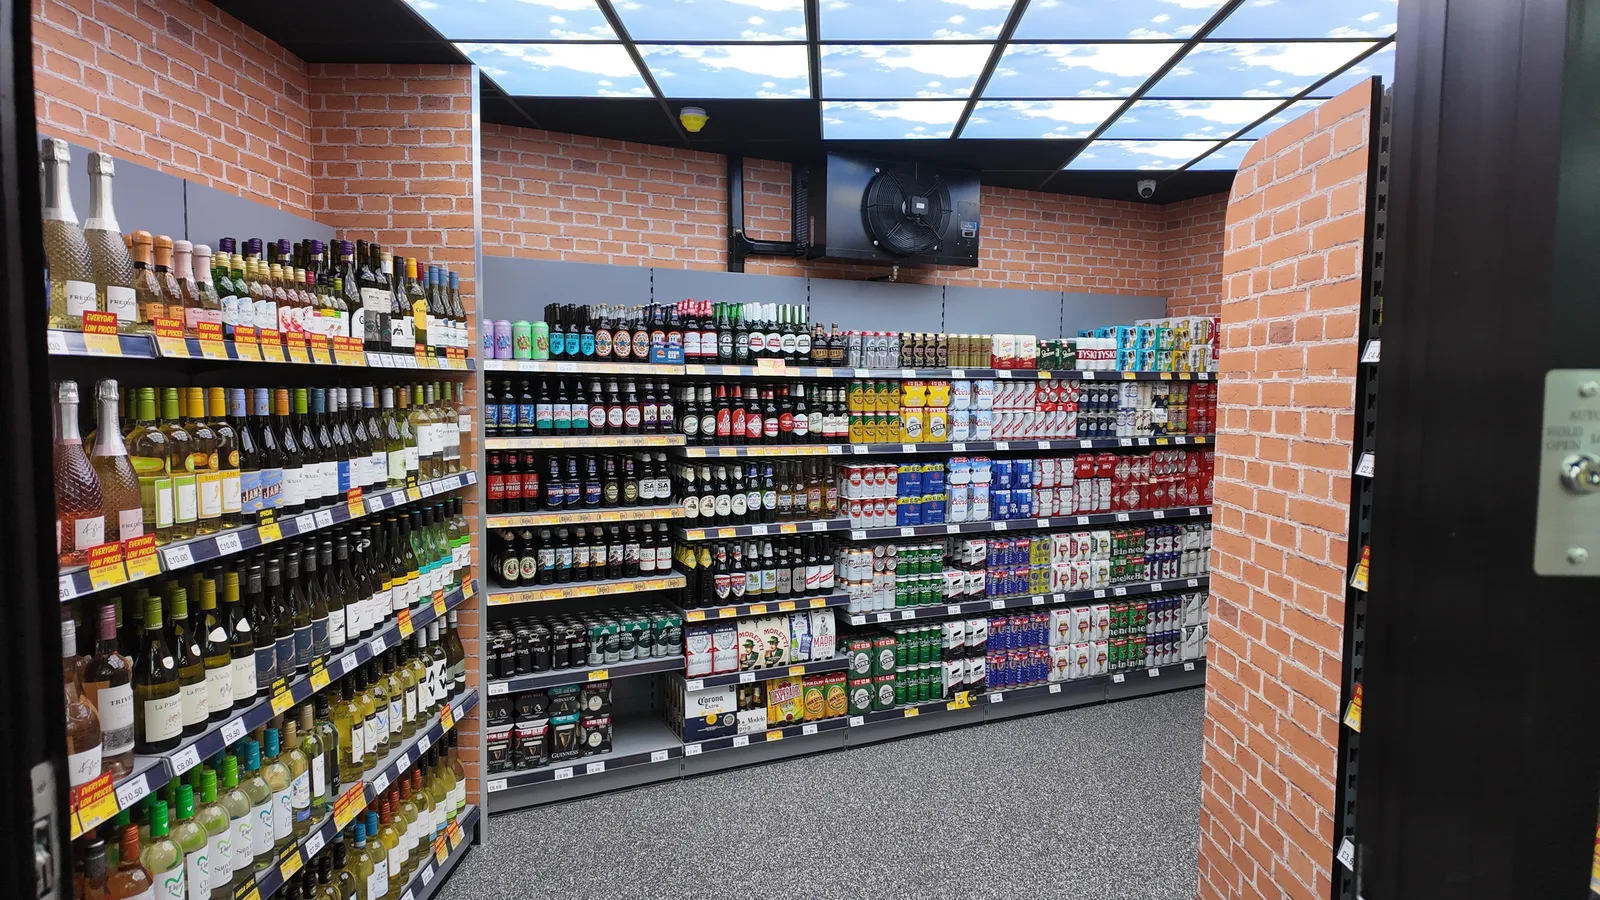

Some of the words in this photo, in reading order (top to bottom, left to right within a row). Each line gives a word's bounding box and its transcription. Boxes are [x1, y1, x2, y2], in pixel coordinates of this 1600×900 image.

[86, 313, 115, 323] EVERYDAY
[157, 318, 180, 328] EVERYDAY
[84, 324, 97, 333] LOW
[97, 325, 117, 334] PRICES
[156, 328, 167, 336] LOW
[167, 329, 182, 338] PRICES
[199, 323, 220, 332] EVERYDAY
[236, 326, 255, 335] EVERYDAY
[208, 333, 222, 341] PRICES
[127, 536, 153, 549] EVERYDAY
[219, 540, 238, 551] £10.00
[91, 544, 119, 557] EVERYDAY
[127, 549, 138, 559] LOW
[138, 546, 155, 557] PRICES
[90, 557, 102, 568] LOW
[102, 553, 121, 566] PRICES
[168, 553, 189, 565] £10.00
[739, 631, 765, 651] MORETTI
[764, 628, 789, 648] MORETTI
[697, 695, 724, 706] Corona
[155, 703, 163, 711] La
[747, 715, 765, 724] Modelo
[225, 728, 241, 742] £9.50
[551, 750, 579, 759] GUINNESS
[176, 757, 194, 772] £8.00
[81, 775, 110, 797] EVERYDAY
[79, 792, 92, 808] LOW
[92, 784, 113, 803] PRICES
[120, 787, 144, 806] £10.50
